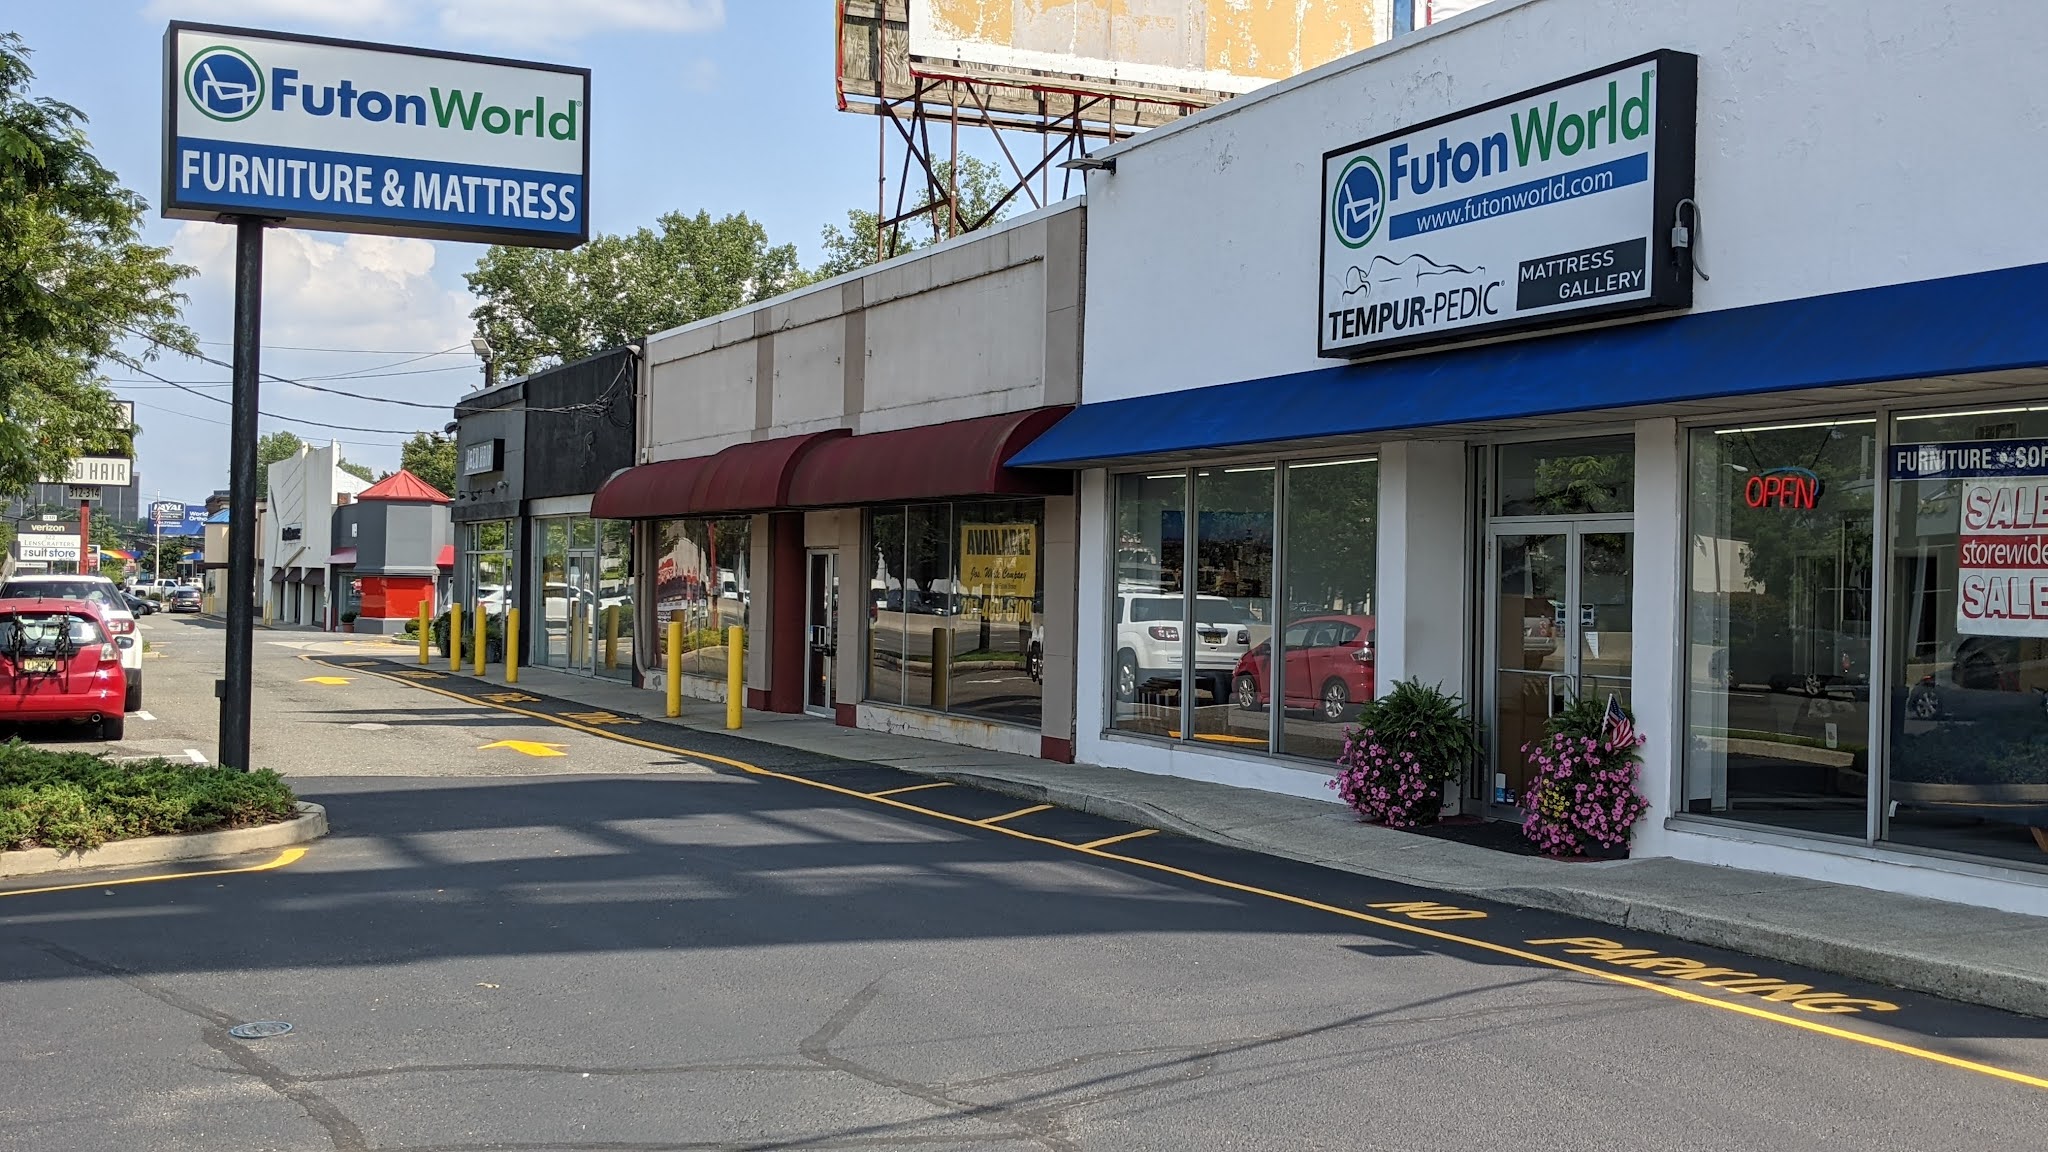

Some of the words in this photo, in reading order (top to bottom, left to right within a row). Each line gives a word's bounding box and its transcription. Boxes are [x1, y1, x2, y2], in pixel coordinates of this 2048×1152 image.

[272, 67, 577, 141] FutonWorld
[1389, 71, 1650, 201] FutonWorld
[182, 149, 372, 205] FURNITURE
[381, 169, 405, 207] &
[414, 171, 576, 223] MATTRESS
[1416, 168, 1613, 233] www.futonworld.com
[1521, 250, 1614, 283] MATTRESS
[1558, 269, 1642, 299] GALLERY
[1329, 284, 1500, 341] TEMPUR-PEDIC
[89, 463, 126, 481] HAIR
[1897, 448, 1992, 472] FURNITURE
[69, 488, 99, 498] 312-314
[1745, 476, 1815, 509] OPEN
[1965, 486, 2048, 530] SALE
[31, 523, 65, 532] verizon
[967, 529, 1030, 555] AVAILABLE
[28, 547, 47, 557] suit
[48, 549, 76, 558] store
[1962, 536, 2048, 565] storewide
[1962, 575, 2048, 620] SALE
[1366, 901, 1488, 920] NO
[1524, 937, 1901, 1014] PARKING
